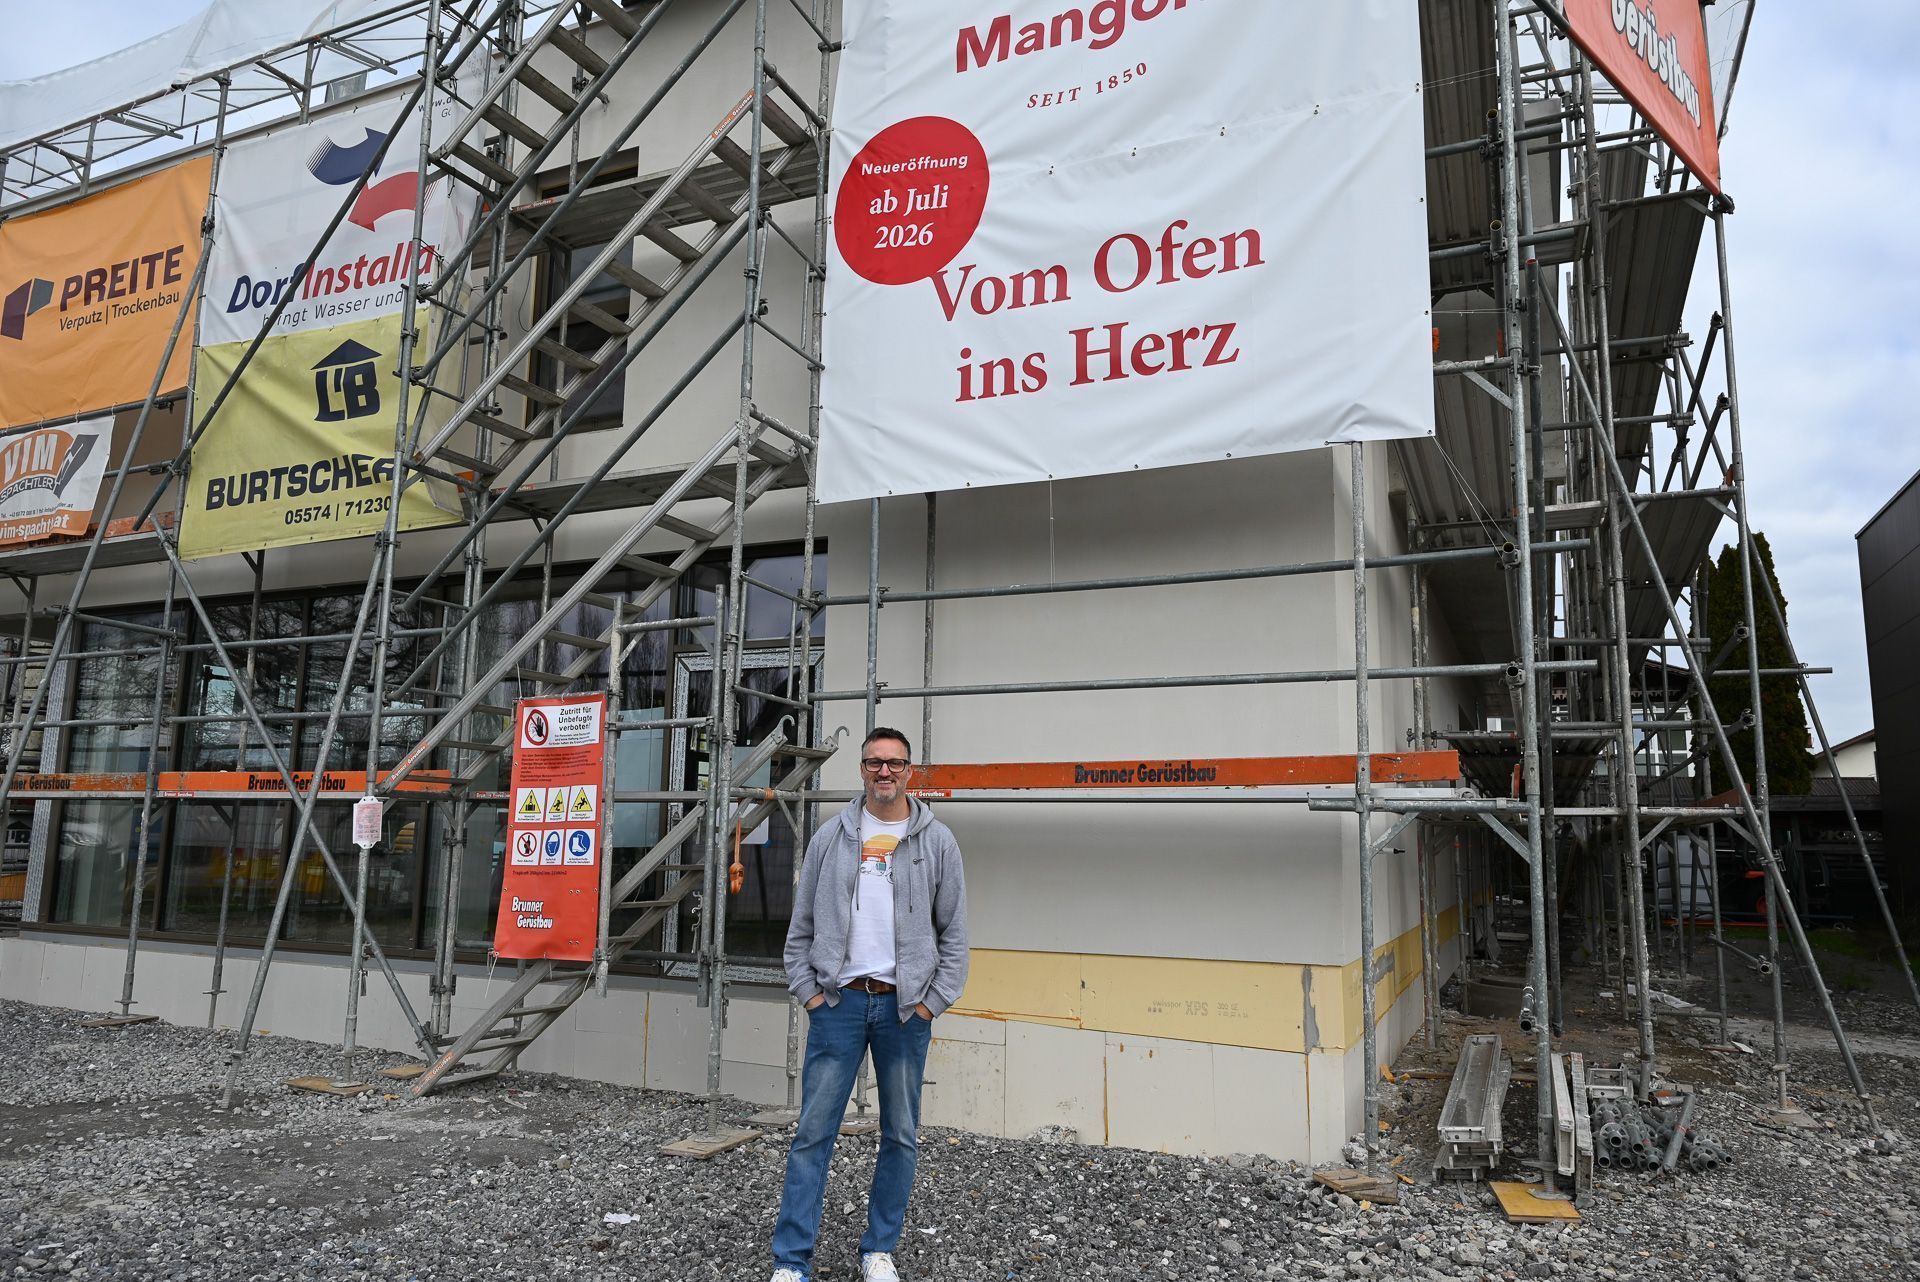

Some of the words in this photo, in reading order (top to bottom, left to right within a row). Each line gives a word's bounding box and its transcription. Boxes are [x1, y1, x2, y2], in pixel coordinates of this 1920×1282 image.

[957, 0, 1188, 74] Mango
[1026, 86, 1082, 109] SEIT
[1095, 62, 1148, 95] 1850
[861, 155, 968, 176] Neueröffnung
[869, 188, 898, 215] ab
[903, 184, 949, 217] Juli
[873, 222, 935, 249] 2026
[60, 244, 184, 313] PREITE
[930, 263, 1072, 322] Vom
[1093, 219, 1266, 293] Ofen
[59, 310, 103, 332] Verputz
[111, 290, 180, 319] Trockenbau
[315, 297, 371, 320] Wasser
[375, 288, 404, 308] und
[955, 347, 1048, 402] ins
[1068, 321, 1240, 387] Herz
[4, 433, 58, 485] VIM
[0, 476, 54, 503] SPACHTLER
[284, 504, 331, 526] 05574
[345, 495, 393, 517] 71230
[558, 714, 593, 724] Unbefugte
[560, 707, 581, 716] Zutritt
[582, 705, 592, 713] für
[29, 774, 71, 790] Gerüstbau
[1074, 765, 1134, 784] Brunner
[1137, 760, 1216, 783] Gerüstbau
[511, 896, 544, 912] Brunner
[516, 914, 553, 928] Gerüstbau
